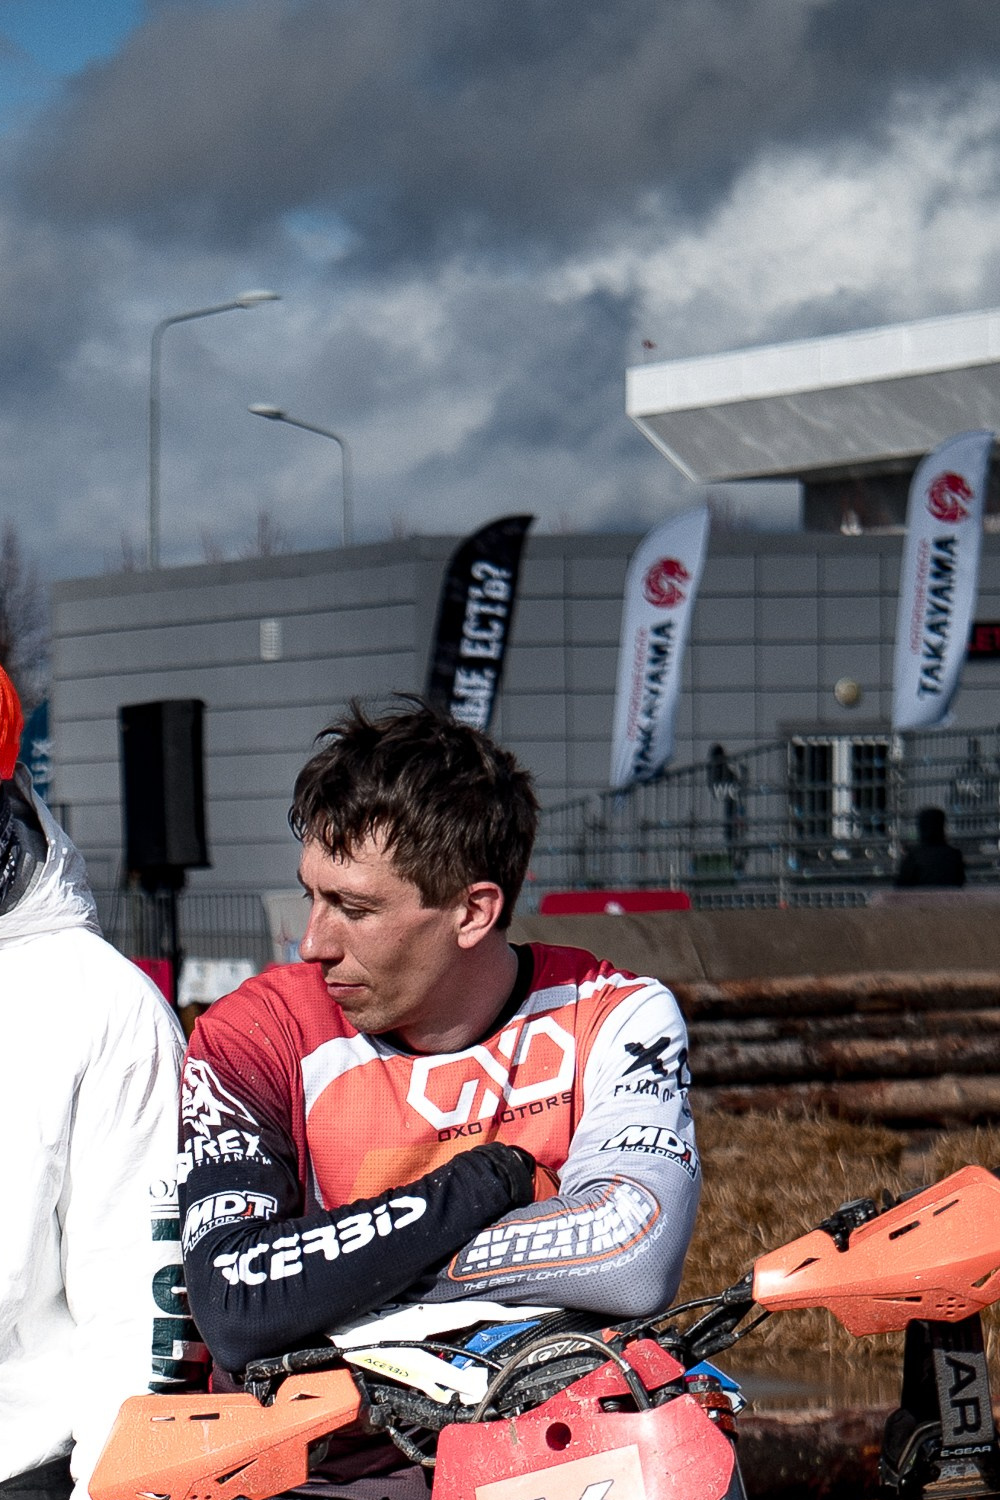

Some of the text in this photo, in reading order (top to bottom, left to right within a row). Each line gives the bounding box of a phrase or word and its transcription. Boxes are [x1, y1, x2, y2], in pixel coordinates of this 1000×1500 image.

[916, 534, 959, 700] TAKAYAMA
[438, 1122, 483, 1142] OXO
[184, 1193, 273, 1242] MDT
[463, 1281, 487, 1292] THE
[488, 1273, 527, 1287] BEST
[526, 1268, 568, 1282] LIGHT
[568, 1265, 600, 1278] FOR
